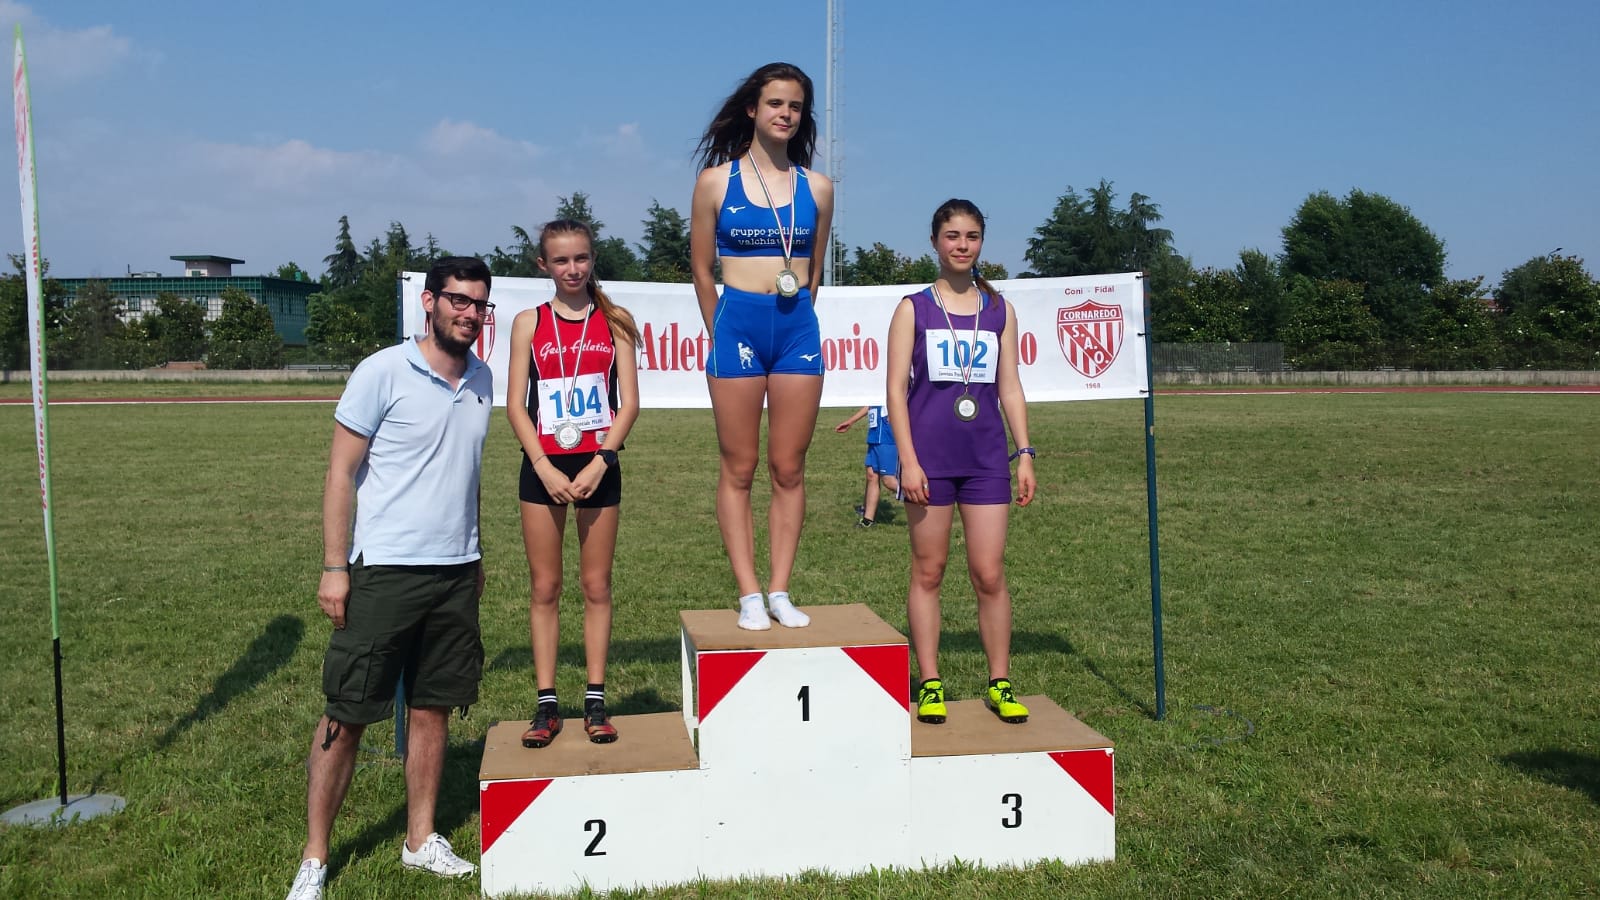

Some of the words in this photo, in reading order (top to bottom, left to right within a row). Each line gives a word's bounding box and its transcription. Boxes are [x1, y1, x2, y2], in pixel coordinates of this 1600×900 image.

[730, 228, 766, 237] gruppo
[1094, 285, 1115, 293] Fidal
[1063, 308, 1117, 320] CORNAREDO
[638, 322, 713, 371] Atlet
[821, 322, 879, 371] orio
[937, 339, 988, 369] 102
[549, 385, 602, 418] 104
[797, 685, 810, 721] 1
[1002, 793, 1022, 829] 3
[584, 819, 607, 857] 2
